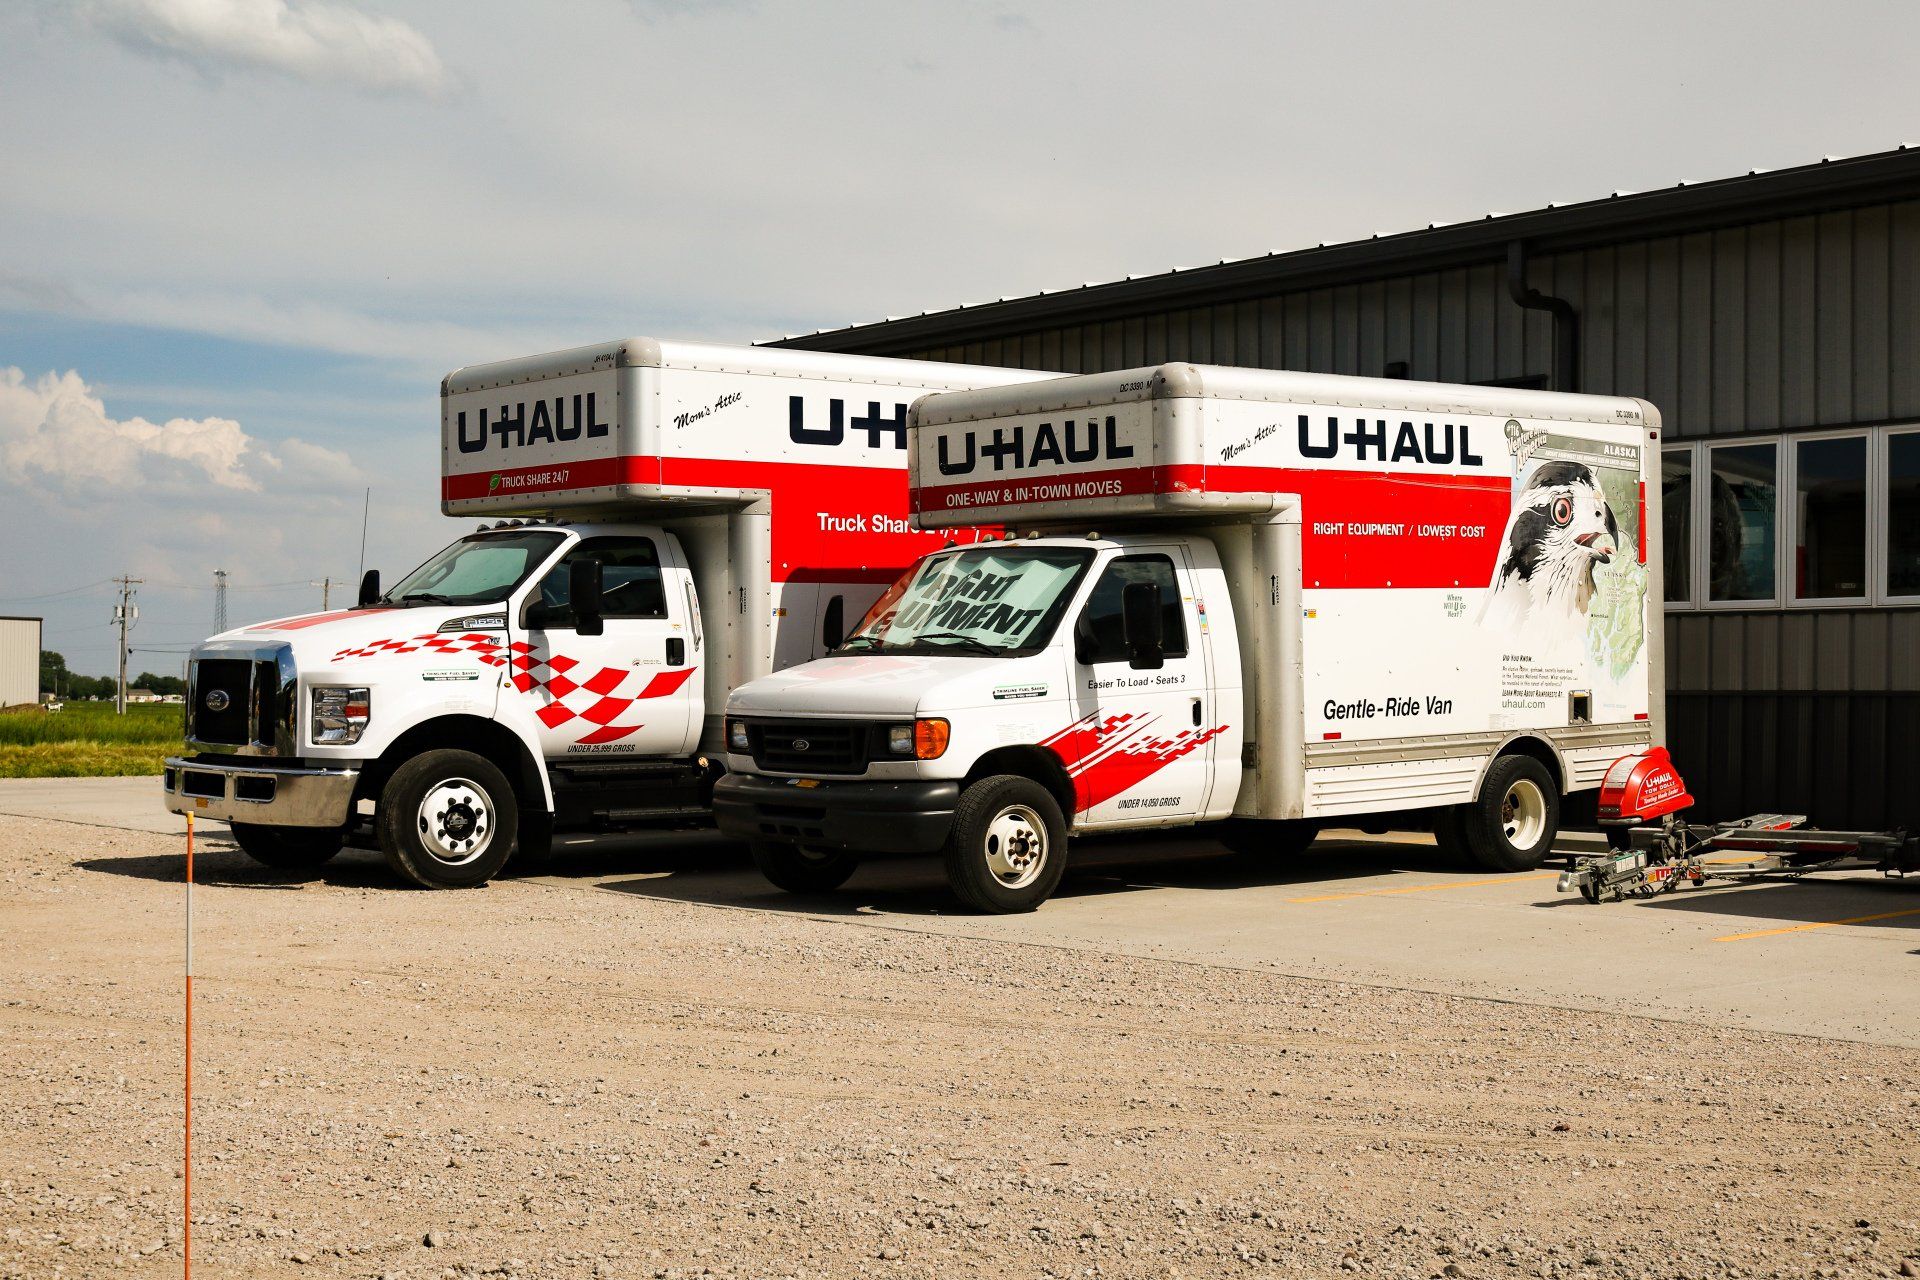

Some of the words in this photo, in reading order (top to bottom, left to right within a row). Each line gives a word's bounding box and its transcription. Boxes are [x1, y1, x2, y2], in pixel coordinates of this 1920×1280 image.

[673, 405, 711, 430] Mom's
[714, 392, 742, 413] Attic
[458, 392, 609, 453] U-HAUL
[789, 395, 908, 450] U-H
[938, 415, 1134, 476] U-HAUL
[1220, 438, 1251, 462] Mom's
[1253, 423, 1277, 445] Attic
[1298, 414, 1483, 466] U-HAUL
[1603, 444, 1637, 459] ALASKA
[501, 475, 526, 488] TRUCK
[527, 473, 551, 486] SHARE
[552, 470, 570, 484] 24/7
[946, 489, 1001, 507] ONE-WAY
[1003, 490, 1013, 502] &
[1015, 484, 1071, 501] IN-TOWN
[1074, 480, 1122, 497] MOVES
[816, 512, 868, 532] Truck
[1313, 522, 1345, 535] RIGHT
[1347, 523, 1405, 536] EQUIPMENT
[1408, 524, 1414, 536] /
[1417, 524, 1457, 537] LOWEST
[1460, 525, 1486, 538] COST
[1088, 679, 1114, 690] Easier
[1116, 678, 1126, 688] To
[1128, 676, 1149, 687] Load
[1155, 675, 1179, 685] Seats
[1180, 674, 1186, 683] 3
[1323, 696, 1420, 720] Gentle-Ride
[1425, 695, 1453, 715] Van
[1501, 698, 1546, 709] uhaul.com
[567, 744, 592, 753] UNDER
[612, 744, 636, 753] GROSS
[1644, 787, 1658, 795] TOW
[1659, 780, 1676, 790] DOLLY
[1645, 772, 1673, 788] U-HAUL
[1117, 798, 1140, 809] UNDER
[1158, 796, 1181, 807] GROSS
